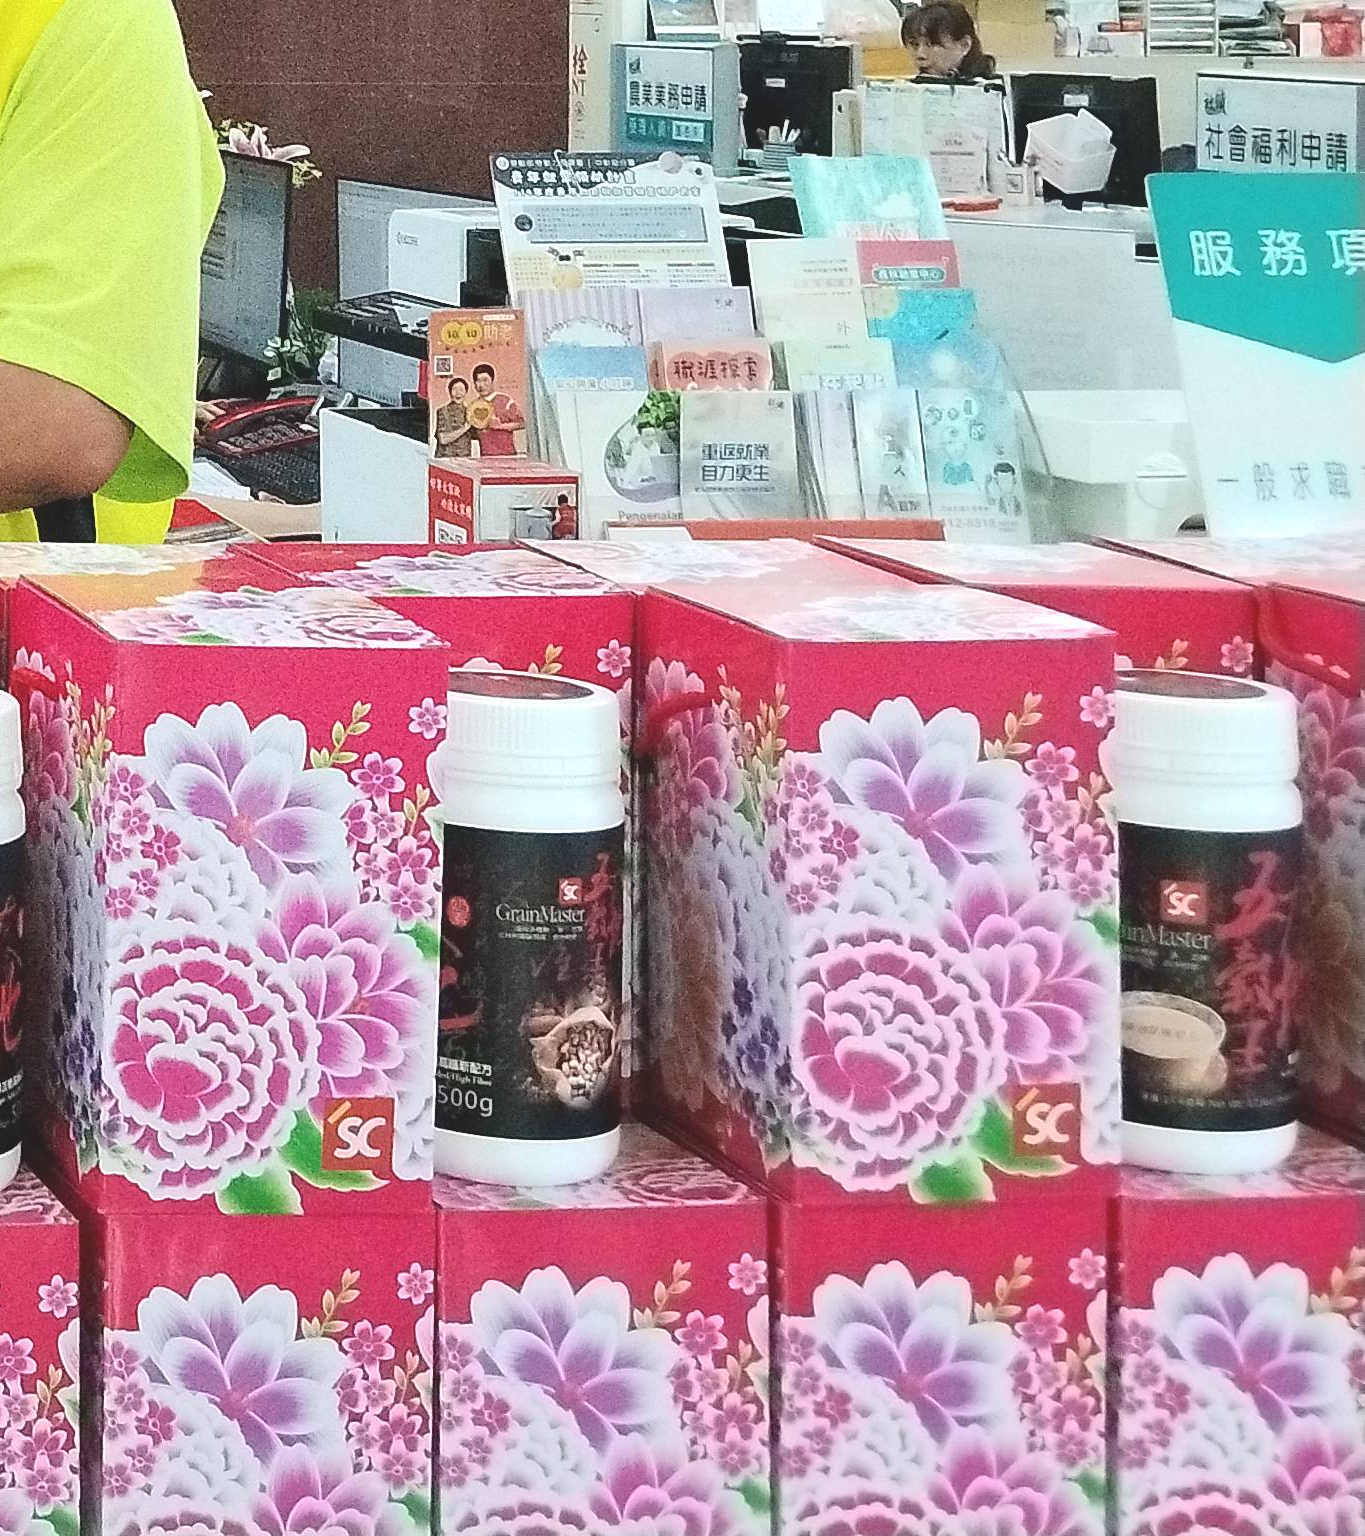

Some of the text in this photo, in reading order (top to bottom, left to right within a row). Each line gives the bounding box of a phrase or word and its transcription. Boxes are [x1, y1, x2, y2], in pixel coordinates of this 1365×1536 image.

[1204, 123, 1349, 173] 社會福利申請
[495, 902, 587, 924] GrainMaster
[437, 1084, 494, 1118] 500g
